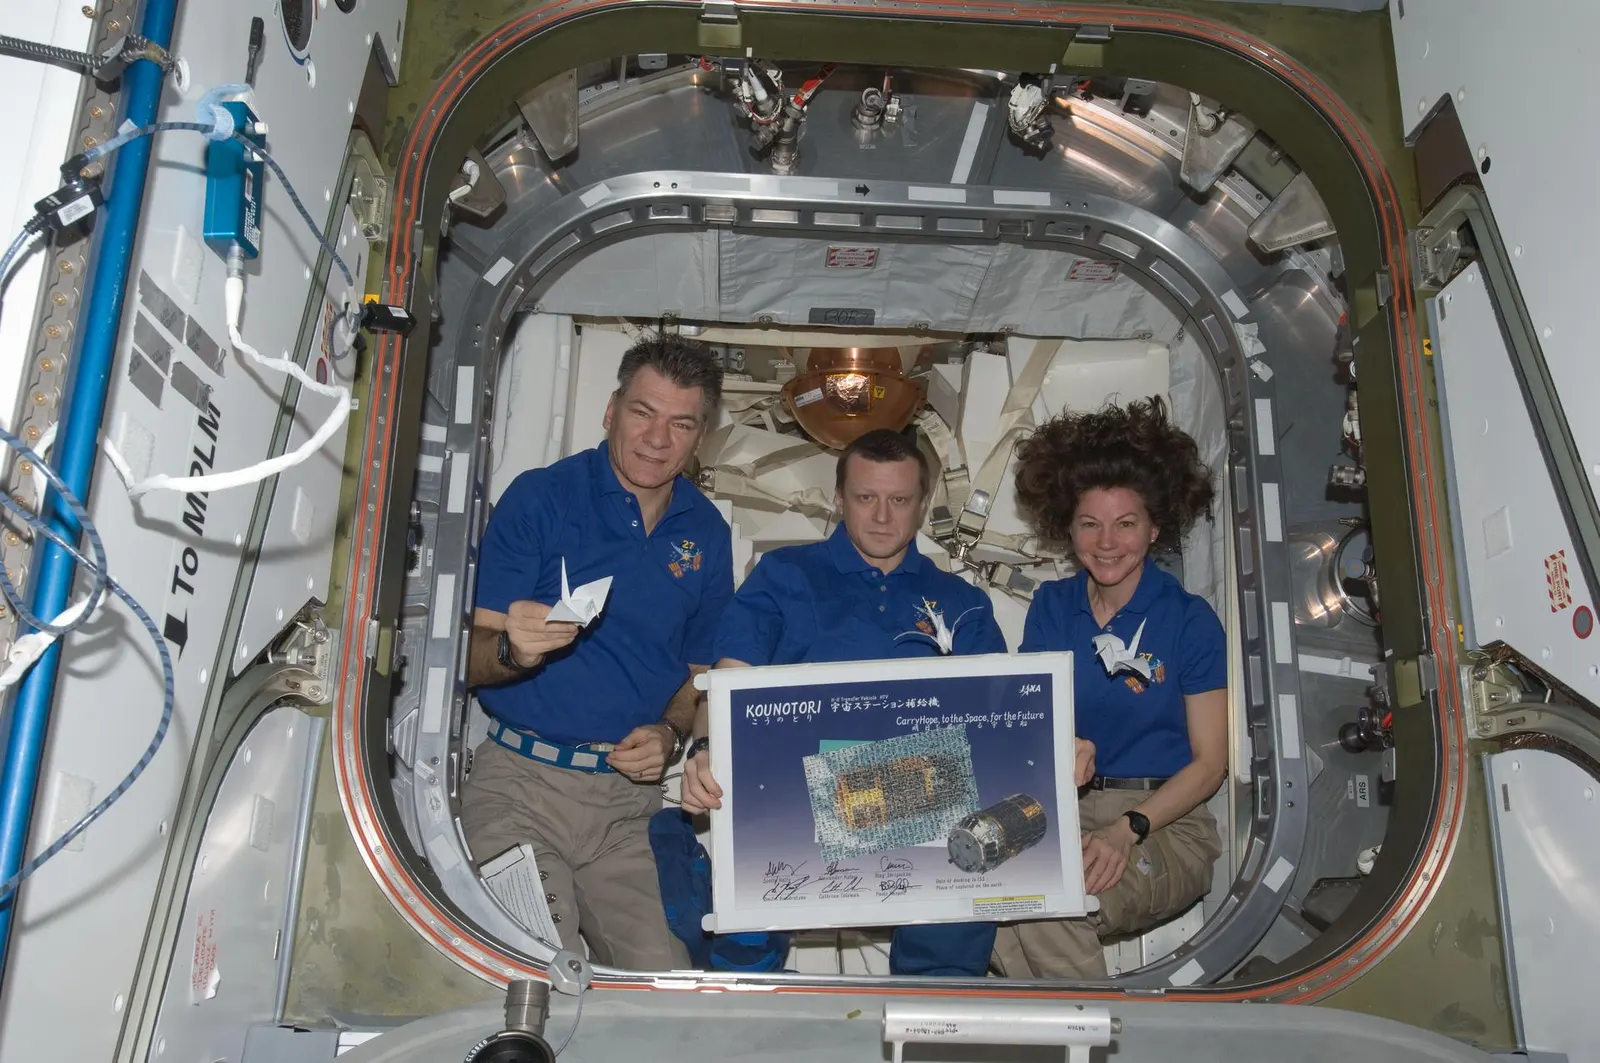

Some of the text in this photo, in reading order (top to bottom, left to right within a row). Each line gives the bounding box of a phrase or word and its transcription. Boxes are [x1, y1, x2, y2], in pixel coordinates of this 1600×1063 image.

[682, 539, 695, 549] 27
[1019, 684, 1041, 698] JAXA
[746, 700, 822, 718] KOUNOTORI
[830, 696, 940, 713] 宇宙ステーション補給機
[990, 711, 1003, 723] for
[1003, 711, 1017, 721] the
[1017, 710, 1045, 720] Future
[1358, 781, 1367, 800] ARS
[465, 1039, 488, 1062] CLOSED
